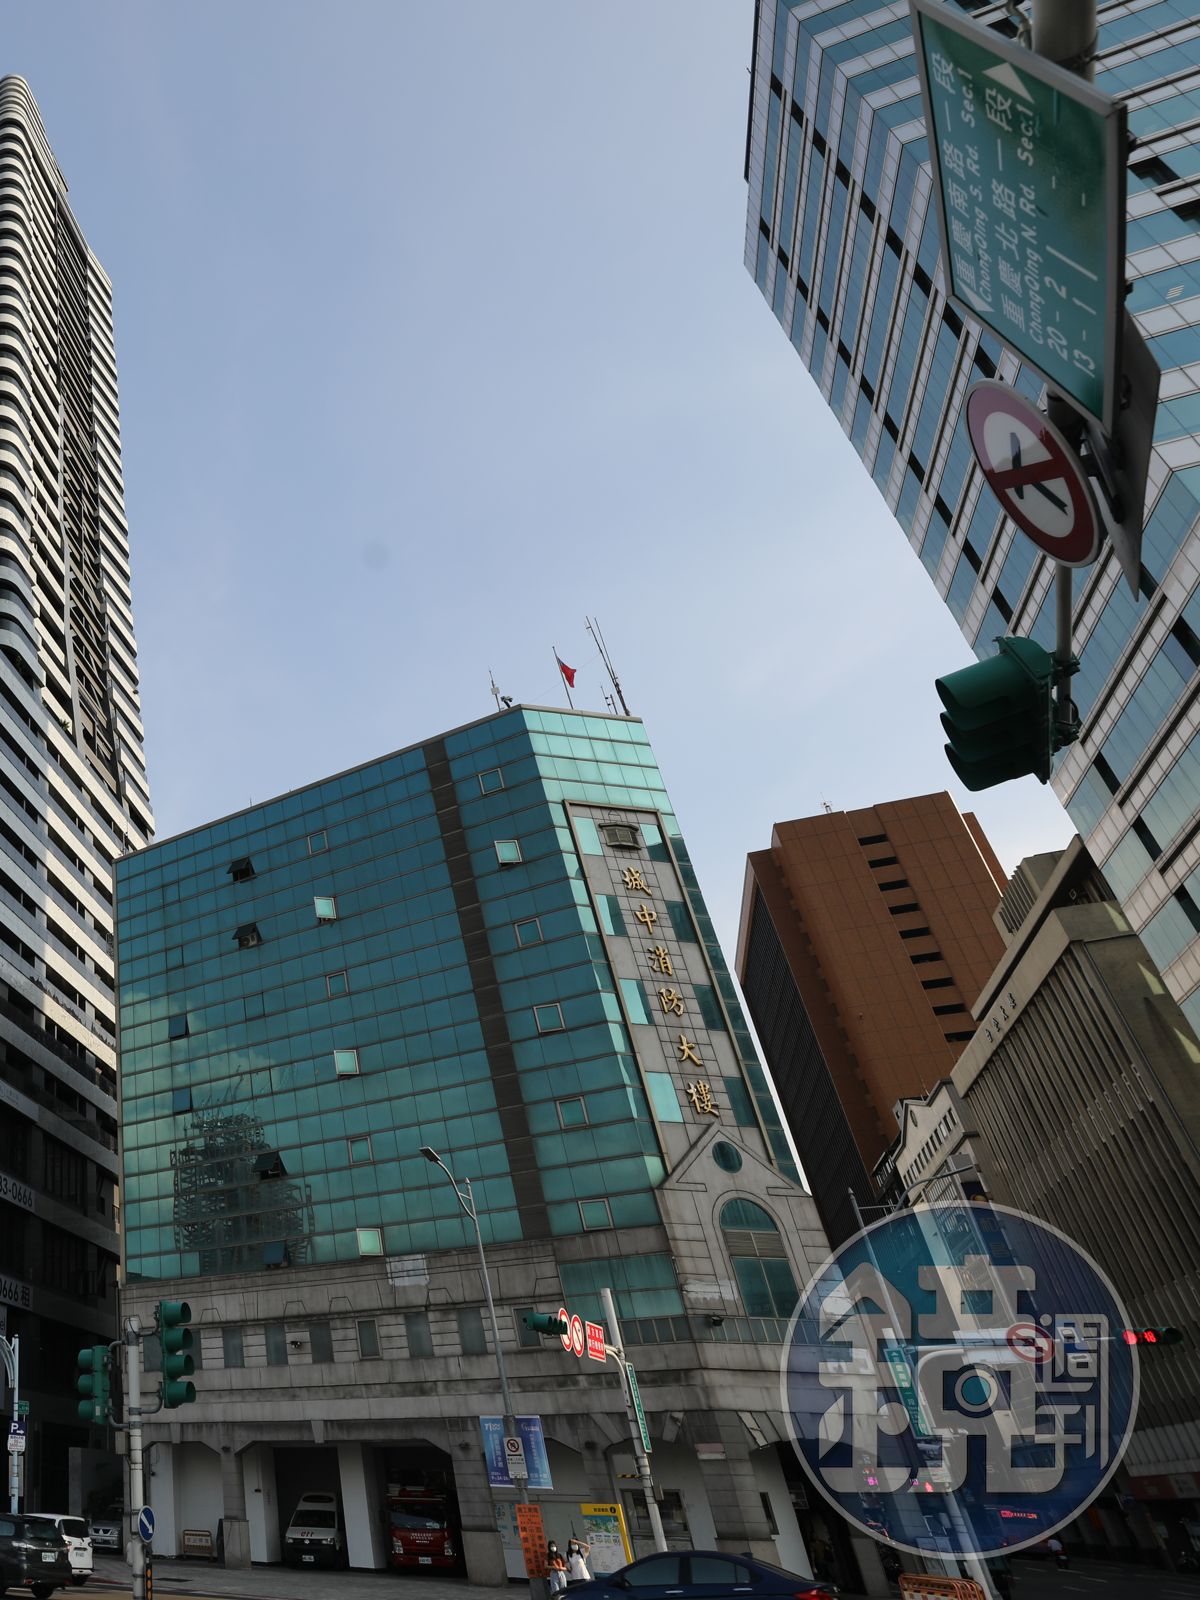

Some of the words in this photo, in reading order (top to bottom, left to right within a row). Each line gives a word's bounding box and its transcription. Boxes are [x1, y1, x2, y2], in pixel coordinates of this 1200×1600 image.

[957, 65, 975, 128] Sec.1
[967, 145, 982, 177] Rd.
[1017, 103, 1034, 167] Sec.1
[931, 51, 977, 291] 重慶南路一段
[969, 184, 983, 203] S.
[1019, 184, 1036, 217] Rd.
[985, 87, 1025, 332] 重慶北路一段
[1021, 225, 1037, 244] N.
[622, 866, 720, 1117] 城中消防大樓
